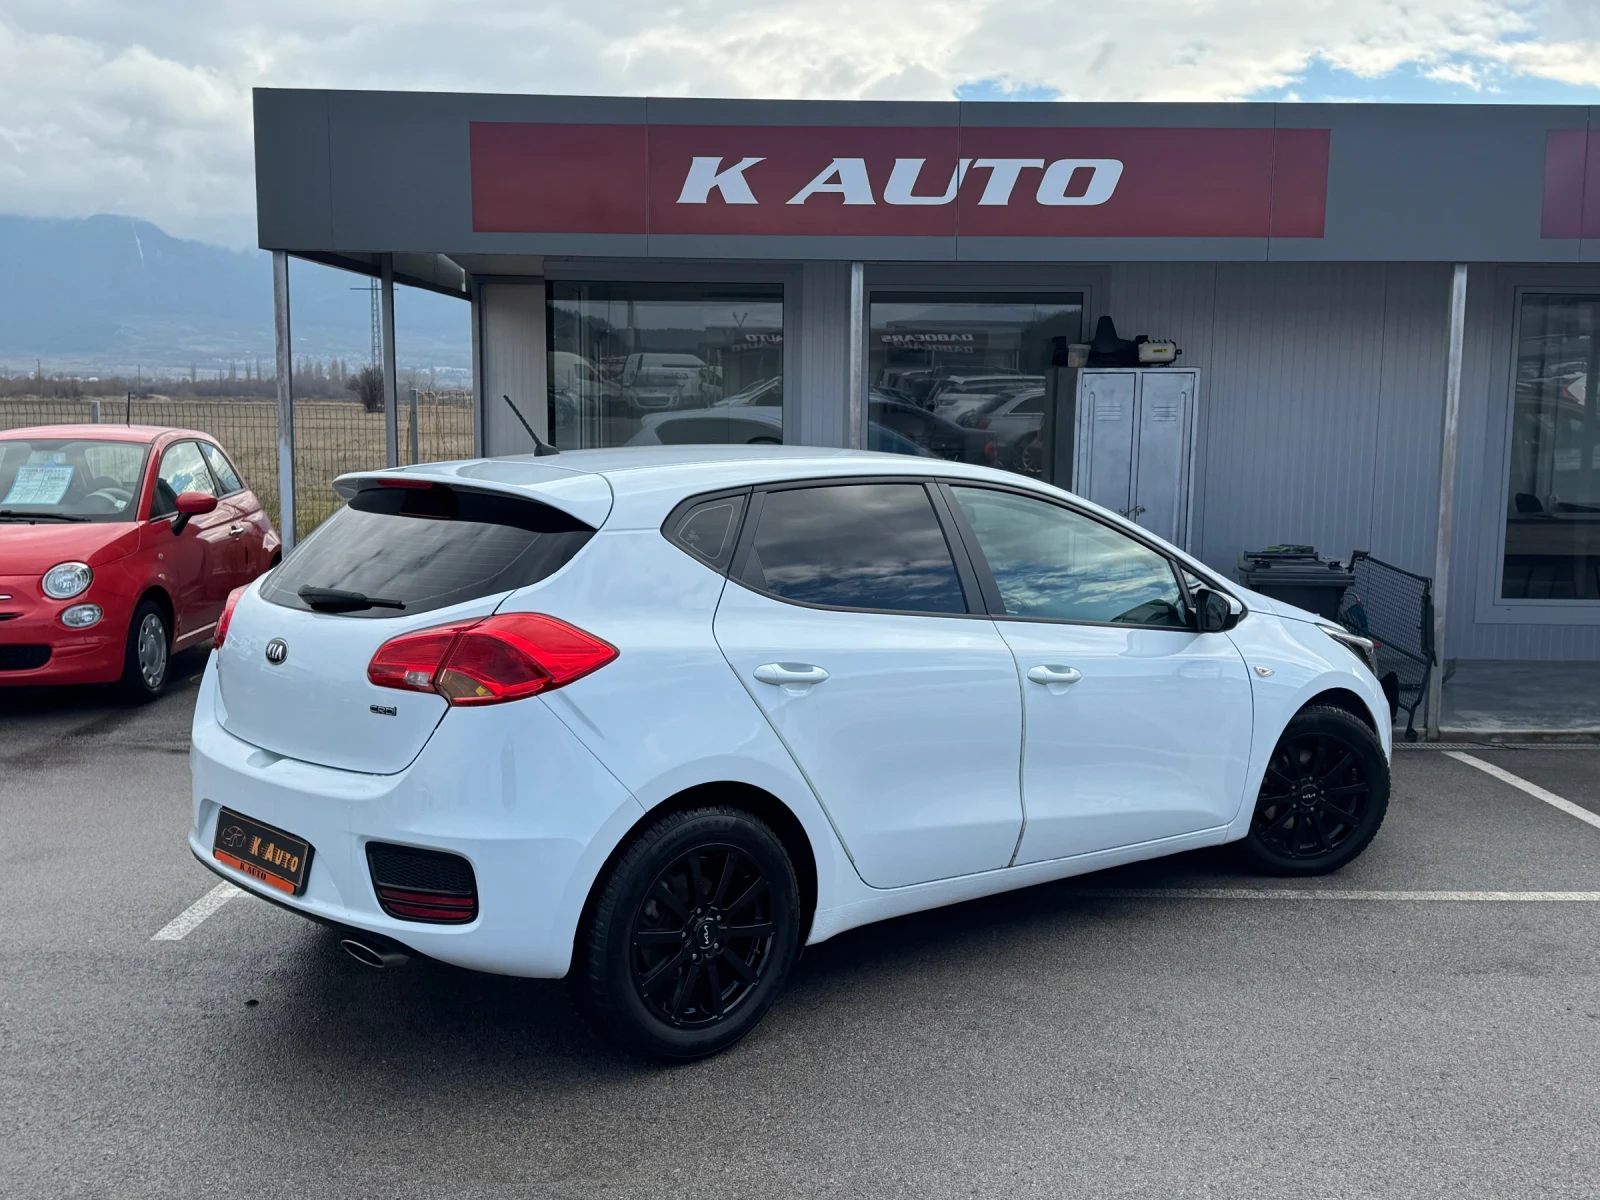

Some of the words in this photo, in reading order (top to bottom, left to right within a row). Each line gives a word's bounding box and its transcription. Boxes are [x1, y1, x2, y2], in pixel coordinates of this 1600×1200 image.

[675, 156, 768, 204] K
[785, 157, 1124, 206] AUTO
[267, 643, 283, 660] KIA
[250, 835, 262, 857] K
[264, 843, 299, 873] AUTO
[239, 862, 246, 872] K
[246, 866, 267, 881] AUTO
